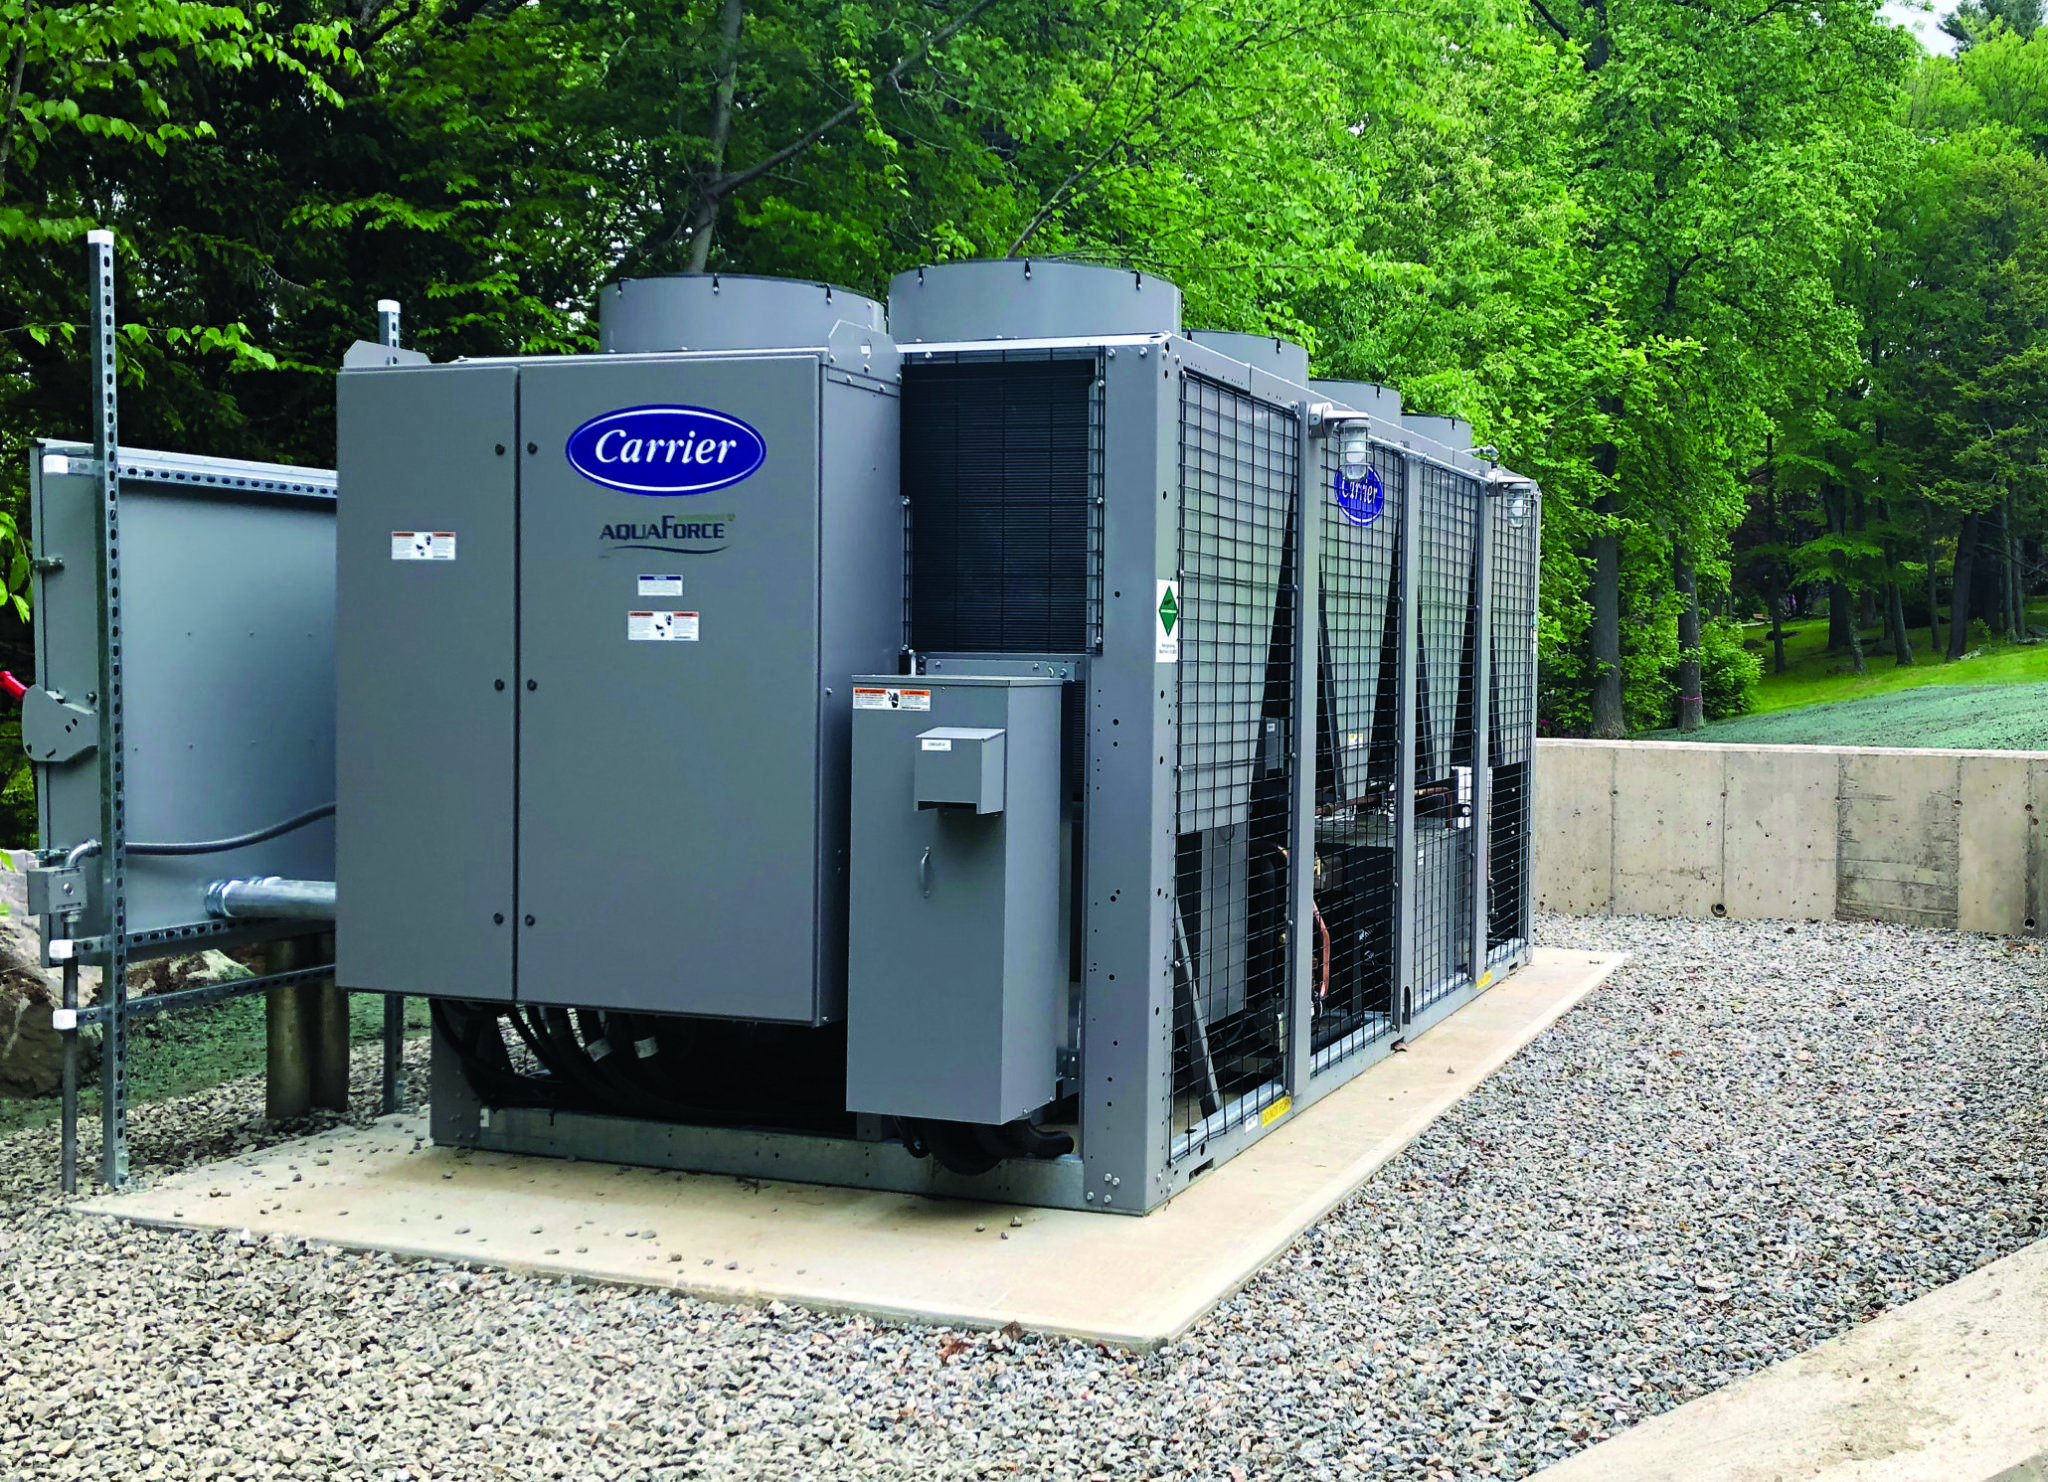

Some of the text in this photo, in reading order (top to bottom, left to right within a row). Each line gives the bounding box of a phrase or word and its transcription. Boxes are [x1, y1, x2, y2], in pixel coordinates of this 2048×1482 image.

[594, 429, 737, 465] Carrier
[1341, 477, 1378, 504] Carrier
[600, 515, 725, 541] AQUAFORCE
